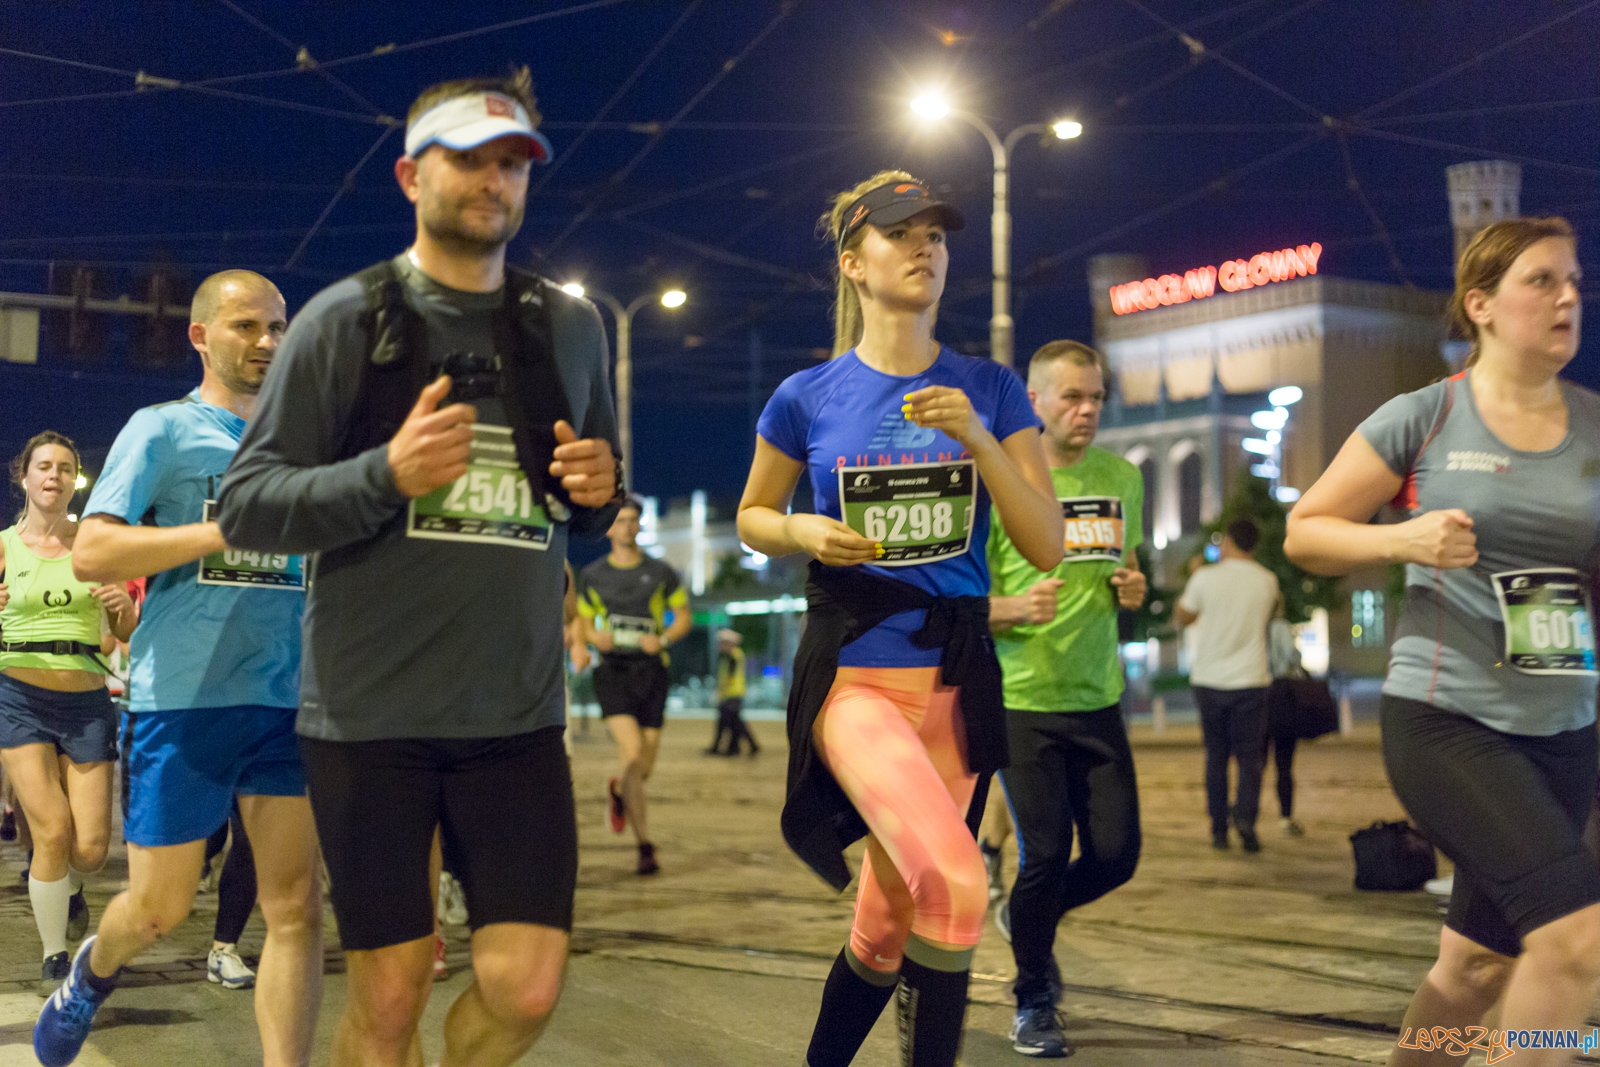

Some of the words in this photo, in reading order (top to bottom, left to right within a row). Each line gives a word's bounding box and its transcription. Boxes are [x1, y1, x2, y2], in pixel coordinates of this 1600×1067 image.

[836, 450, 973, 468] RUNNIN
[442, 470, 532, 519] 2541
[863, 501, 953, 543] 6298
[1066, 520, 1115, 544] 4515
